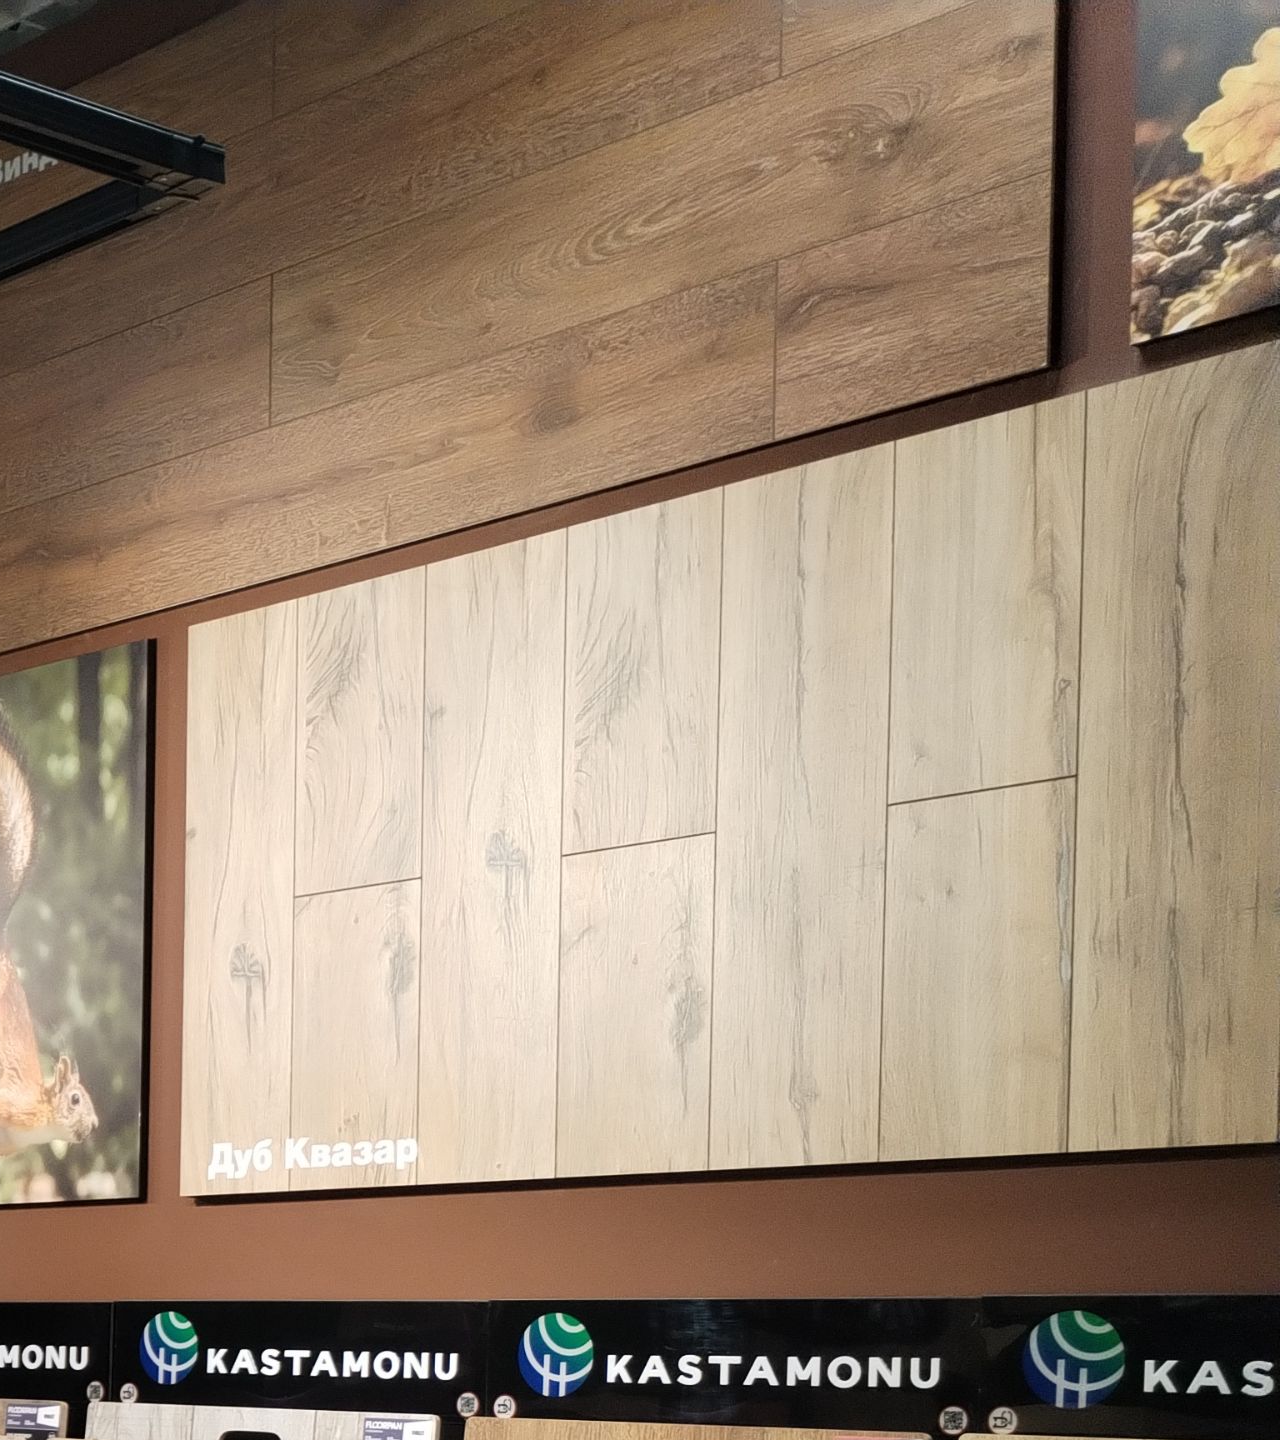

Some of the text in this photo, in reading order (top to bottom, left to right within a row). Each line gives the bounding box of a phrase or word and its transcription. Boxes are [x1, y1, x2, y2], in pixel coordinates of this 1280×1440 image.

[207, 1136, 418, 1180] Дуб Квазар
[206, 1347, 460, 1381] KASTAMONU
[606, 1354, 940, 1389] KASTAMONU
